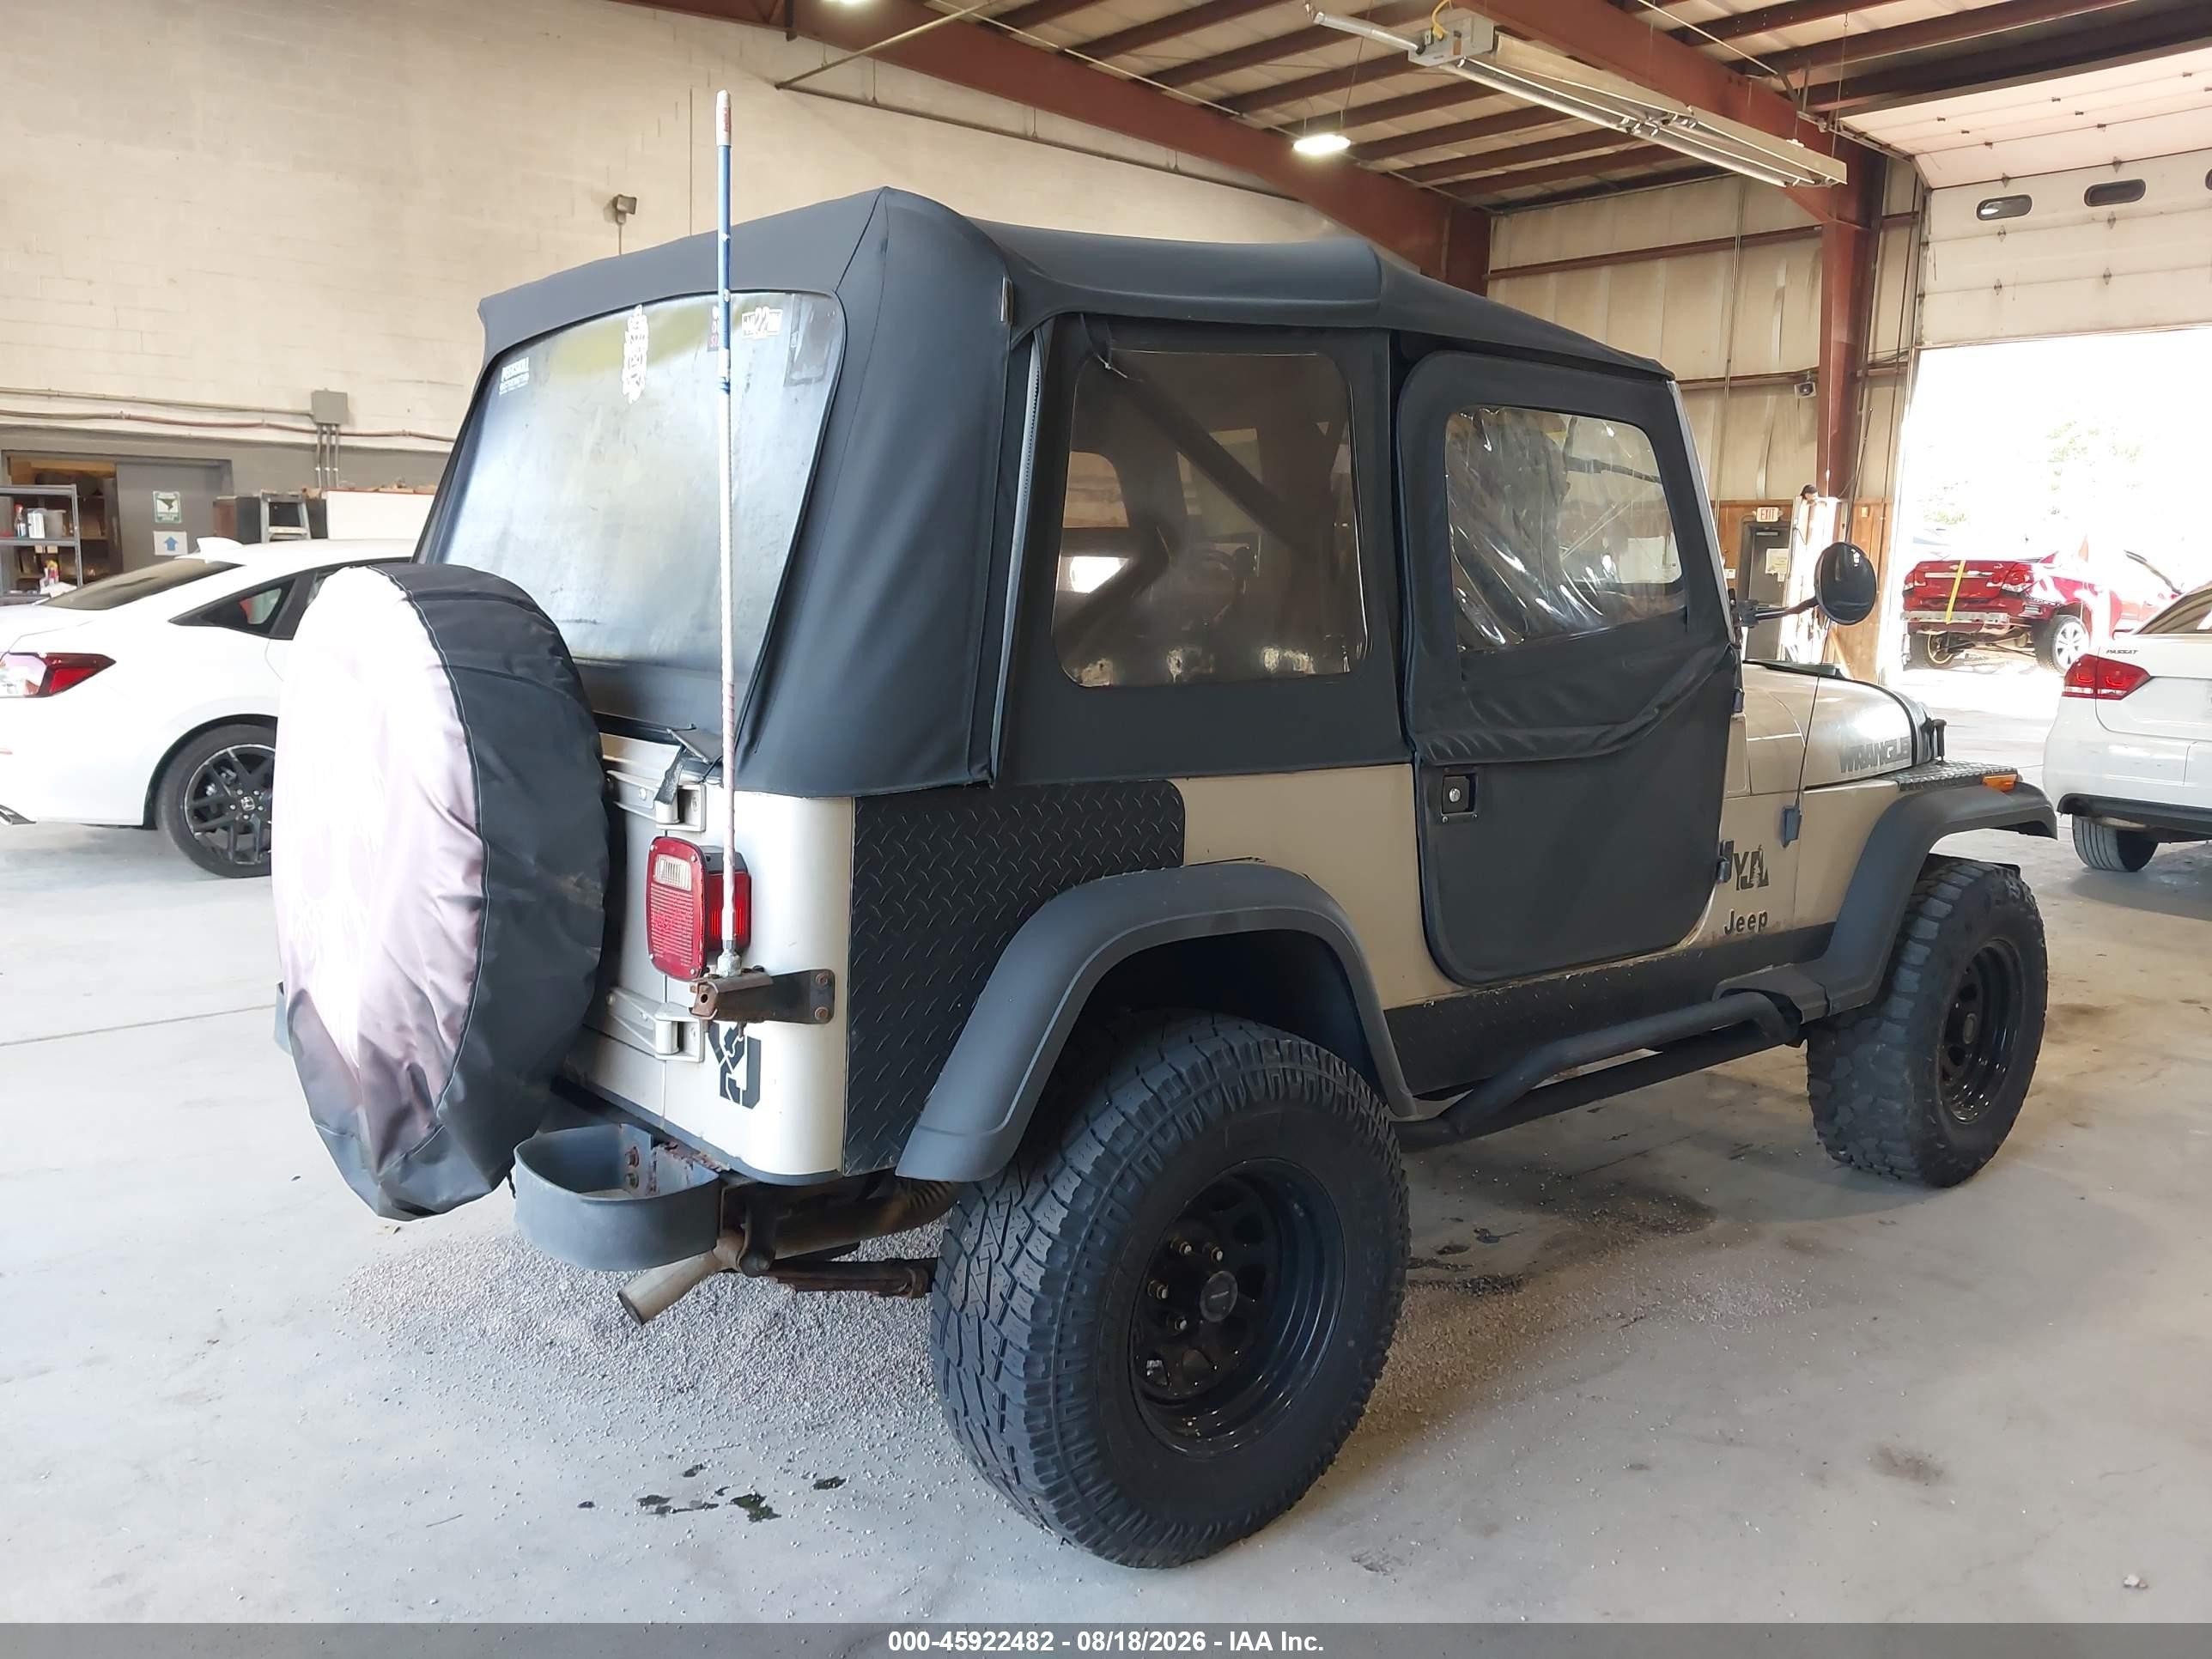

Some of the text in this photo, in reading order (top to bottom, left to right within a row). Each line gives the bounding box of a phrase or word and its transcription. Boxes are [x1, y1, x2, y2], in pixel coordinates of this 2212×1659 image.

[1760, 508, 1776, 520] EXIT
[1839, 736, 1911, 773] WRANGLE
[1723, 910, 1769, 935] Jeep
